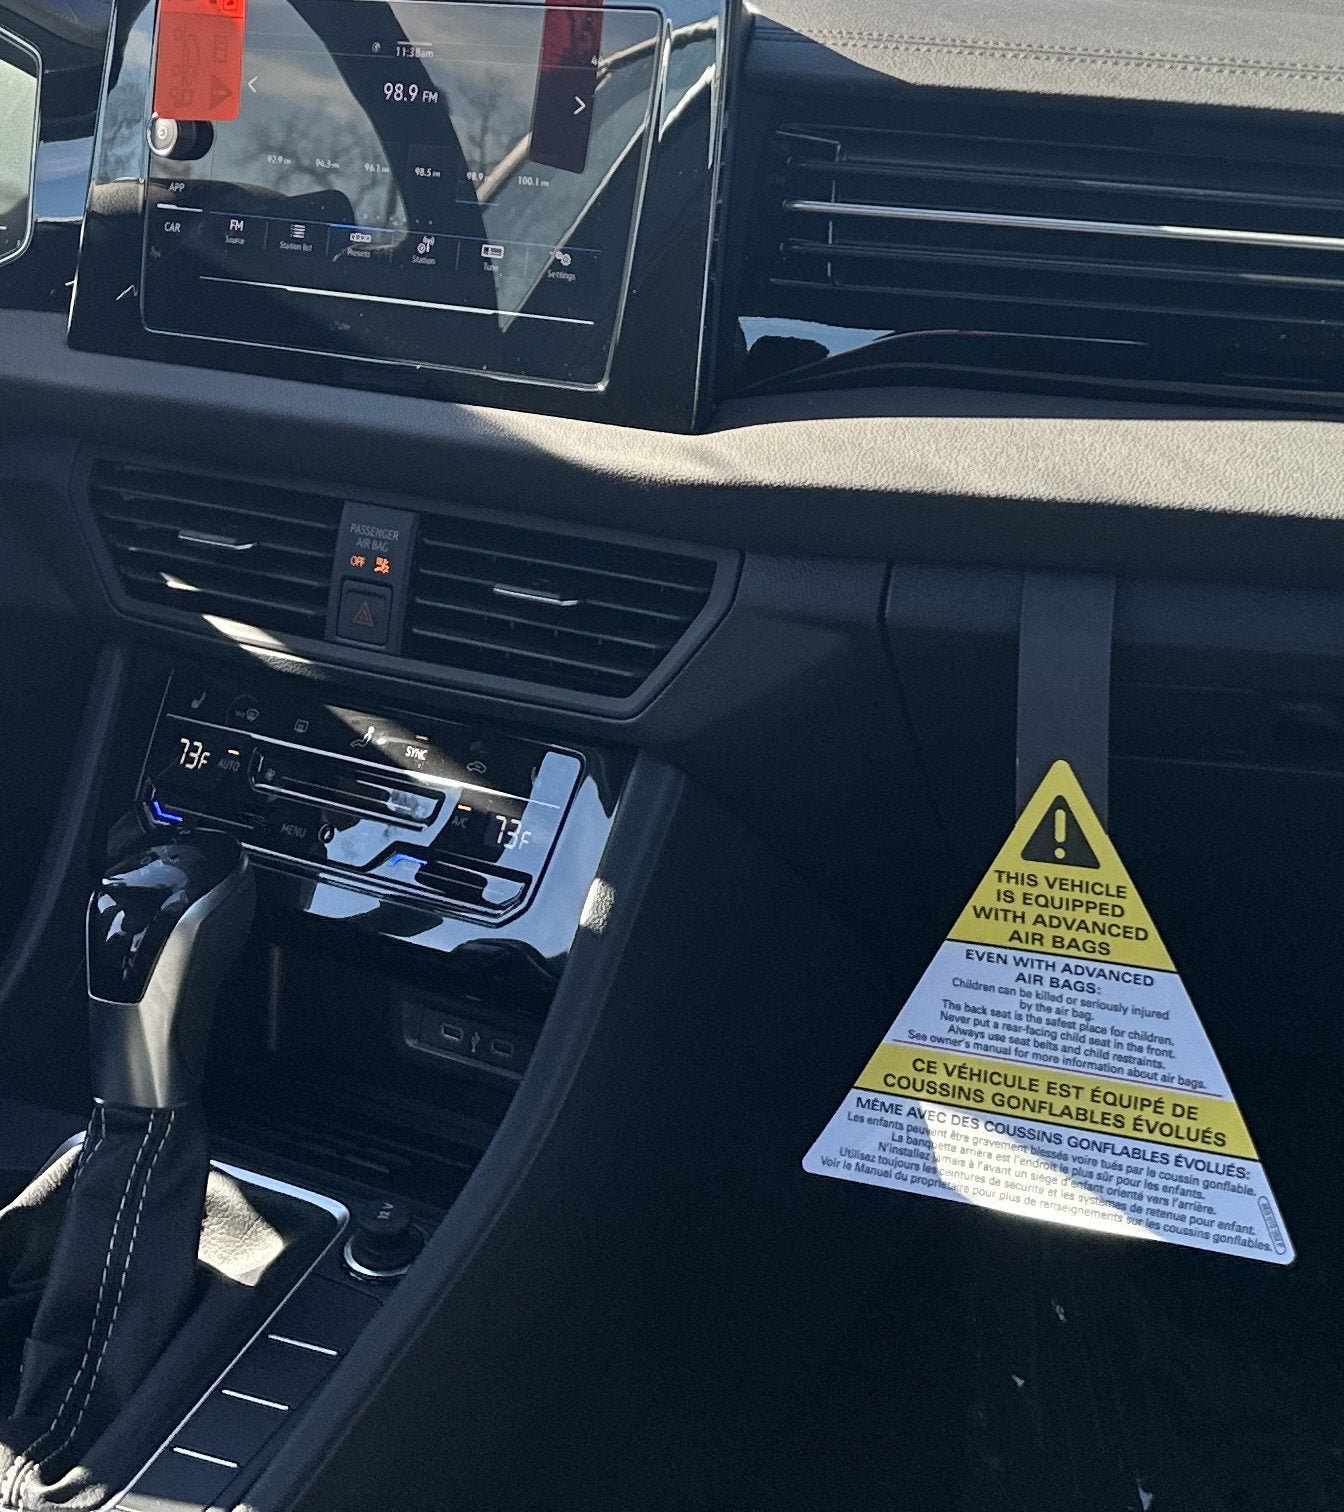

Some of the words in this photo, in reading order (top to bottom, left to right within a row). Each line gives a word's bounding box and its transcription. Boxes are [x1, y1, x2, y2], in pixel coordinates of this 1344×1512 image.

[383, 82, 419, 103] 98.9
[422, 90, 438, 104] FM
[169, 182, 185, 192] APP
[164, 222, 181, 233] CAR
[229, 219, 244, 232] FM
[349, 523, 399, 541] PASSENGER
[356, 537, 371, 548] AIR
[371, 540, 389, 552] BAG
[217, 759, 241, 772] AUTO
[405, 746, 427, 761] SYNC
[281, 824, 306, 838] MENU
[994, 870, 1039, 887] THIS
[1044, 875, 1127, 899] VEHICLE
[996, 888, 1015, 903] IS
[1022, 892, 1125, 918] EQUIPPED
[972, 904, 1026, 924] WITH
[1032, 913, 1149, 942] ADVANCED
[1008, 929, 1044, 947] AIR
[1051, 934, 1111, 956] BAGS
[965, 948, 1008, 965] EVEN
[1012, 955, 1056, 972] WITH
[1061, 963, 1154, 987] ADVANCED
[1014, 972, 1044, 986] AIR
[1049, 977, 1102, 995] BAGS:
[951, 976, 996, 993] Children
[998, 986, 1017, 997] can
[1019, 988, 1033, 999] be
[1035, 989, 1063, 1003] killed
[1065, 996, 1078, 1006] or
[1080, 997, 1129, 1016] seriously
[1131, 1004, 1169, 1021] injured
[1019, 999, 1033, 1012] by
[1035, 1002, 1052, 1014] the
[1055, 1003, 1068, 1016] air
[1071, 1008, 1094, 1022] bag.
[940, 1010, 971, 1025] Never
[973, 1017, 990, 1029] put
[992, 1021, 999, 1029] a
[1002, 1022, 1057, 1041] rear-facing
[1060, 1030, 1086, 1044] child
[1088, 1035, 1111, 1048] seat
[1113, 1038, 1124, 1049] in
[1126, 1041, 1144, 1054] the
[1146, 1043, 1176, 1059] front.
[942, 998, 962, 1010] The
[964, 1002, 987, 1016] back
[990, 1008, 1012, 1019] seat
[1014, 1011, 1023, 1021] is
[1025, 1012, 1043, 1024] the
[1045, 1015, 1076, 1030] safest
[1079, 1022, 1107, 1035] place
[1110, 1025, 1126, 1038] for
[1128, 1029, 1175, 1046] children.
[947, 1023, 985, 1040] Always
[988, 1032, 1006, 1043] use
[1008, 1035, 1031, 1047] seat
[1033, 1038, 1059, 1052] belts
[1061, 1043, 1081, 1055] and
[1083, 1046, 1110, 1060] child
[907, 1028, 928, 1041] See
[930, 1035, 971, 1049] owner's
[973, 1041, 1012, 1056] manual
[1014, 1046, 1029, 1059] for
[1031, 1051, 1060, 1064] more
[1062, 1055, 1125, 1075] information
[1126, 1066, 1159, 1081] about
[1160, 1071, 1176, 1083] air
[1177, 1074, 1207, 1090] bags.
[912, 1057, 938, 1074] CE
[943, 1063, 1039, 1093] VÉHICULE
[1047, 1080, 1084, 1100] EST
[1090, 1085, 1165, 1115] ÉQUIPÉ
[1171, 1103, 1199, 1121] DE
[883, 1073, 985, 1103] COUSSINS
[991, 1092, 1125, 1129] GONFLABLES
[1132, 1115, 1226, 1147] ÉVOLUÉS
[856, 1097, 903, 1116] MÊME
[906, 1106, 947, 1124] AVEC
[951, 1114, 979, 1130] DES
[984, 1120, 1063, 1145] COUSSINS
[1067, 1135, 1170, 1165] GONFLABLES
[1174, 1153, 1251, 1180] ÉVOLUÉS:
